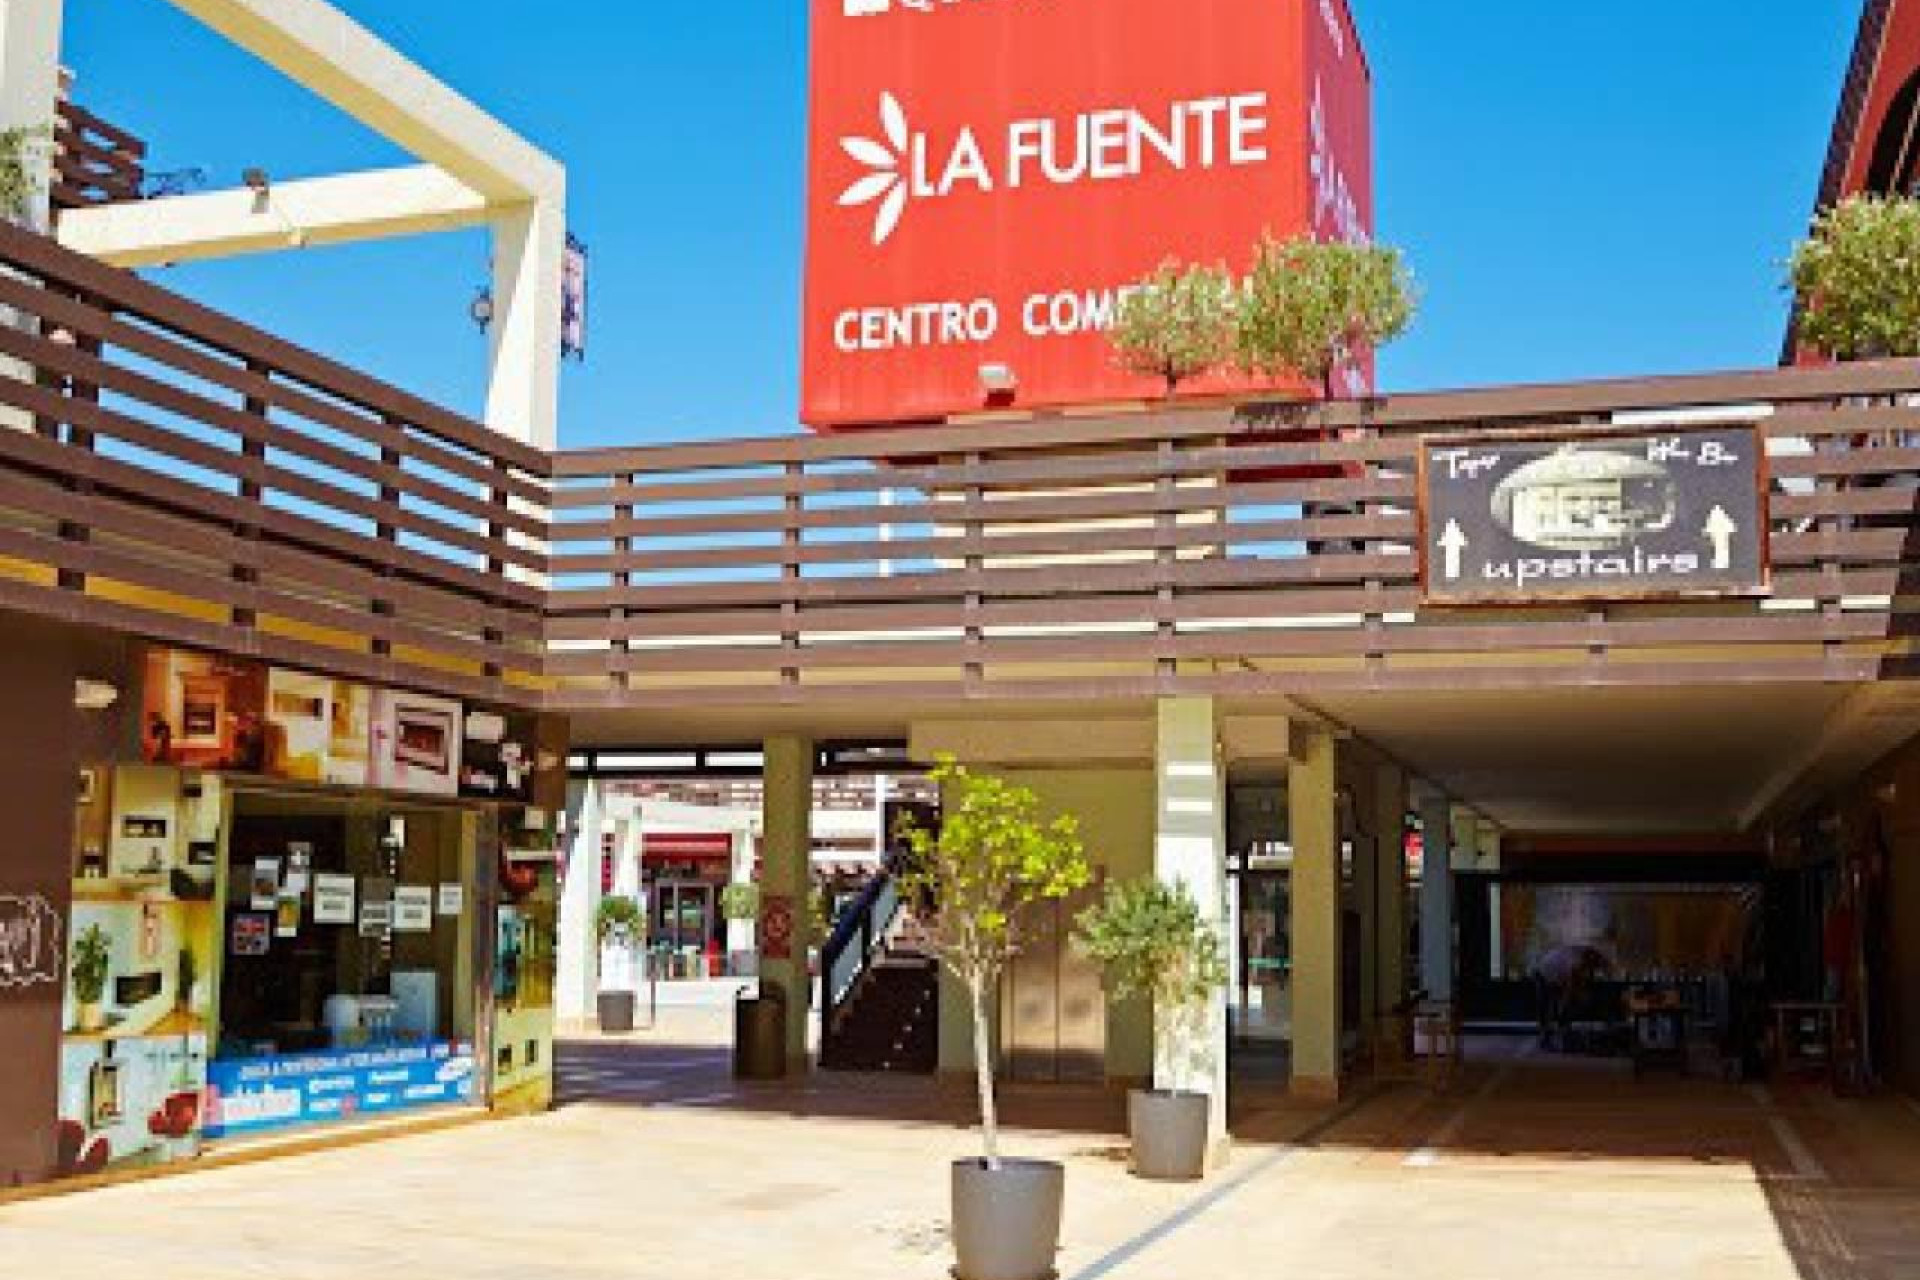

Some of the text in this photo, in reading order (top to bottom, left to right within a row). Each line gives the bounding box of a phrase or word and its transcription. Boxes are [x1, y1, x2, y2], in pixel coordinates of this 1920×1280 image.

[911, 125, 994, 197] LA
[1006, 92, 1267, 188] FUENTE
[833, 297, 998, 351] CENTRO
[1482, 545, 1699, 588] upstairs
